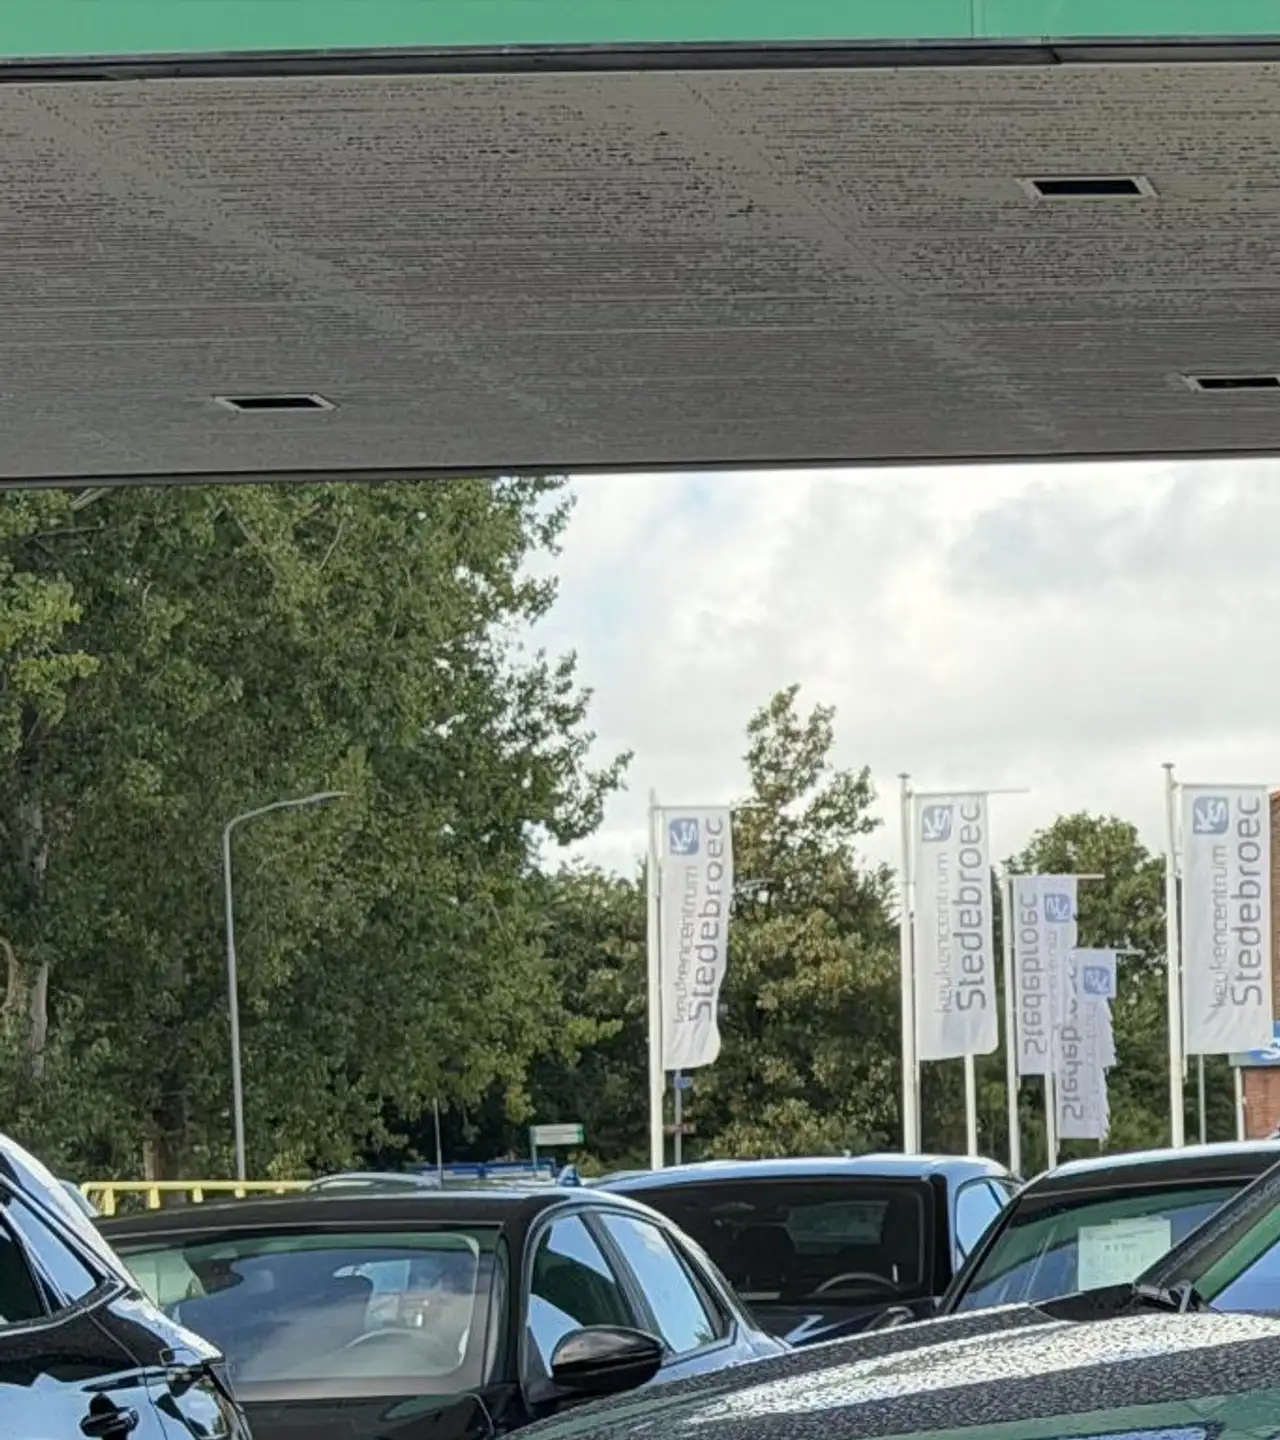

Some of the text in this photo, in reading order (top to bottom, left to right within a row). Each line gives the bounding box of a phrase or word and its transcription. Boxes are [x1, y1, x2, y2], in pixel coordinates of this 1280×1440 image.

[688, 817, 725, 1022] Stedebroec
[952, 794, 987, 1012] Stedebroec
[1208, 845, 1229, 1007] keukencentrum
[1231, 796, 1262, 1007] Stedebroec
